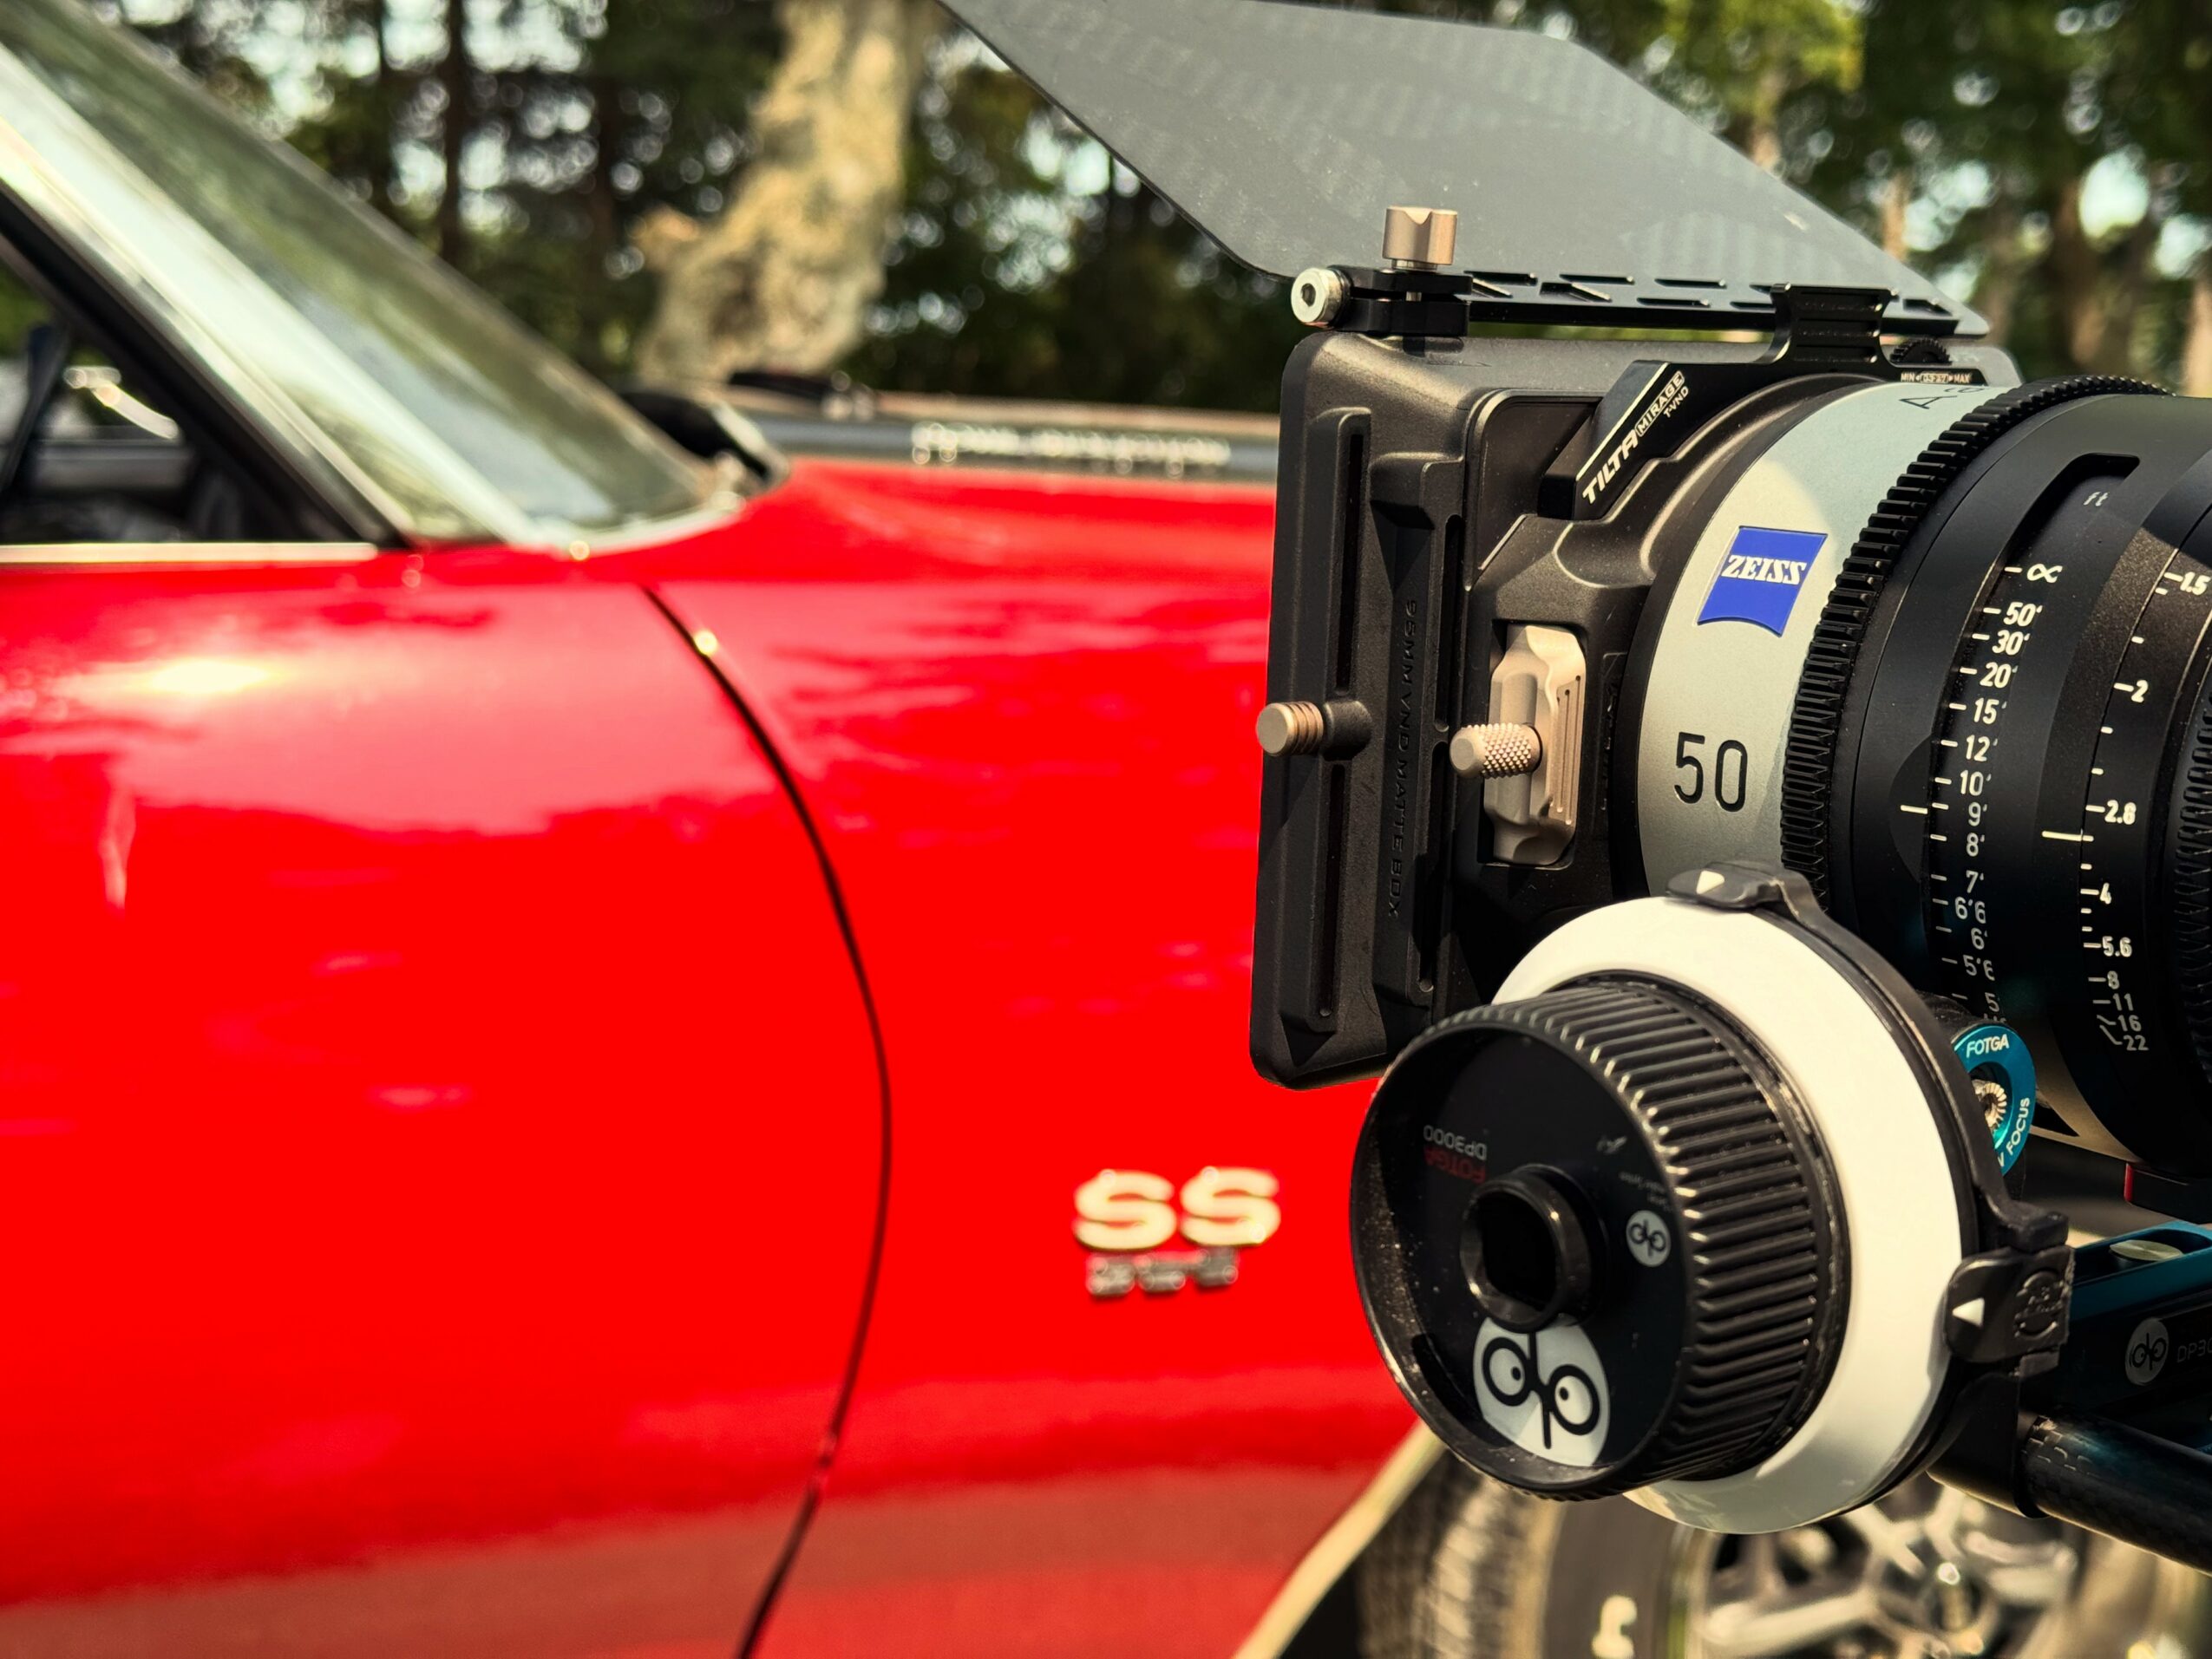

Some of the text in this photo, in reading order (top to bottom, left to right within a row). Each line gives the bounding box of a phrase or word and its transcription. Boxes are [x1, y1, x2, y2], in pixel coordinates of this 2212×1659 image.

[1901, 373, 1914, 382] MIN
[1953, 373, 1971, 383] MAX
[1663, 386, 1689, 418] T-VND
[1582, 372, 1684, 504] TILTA MIRAGE
[2084, 492, 2109, 506] ft
[1721, 555, 1807, 585] ZEISS
[2180, 572, 2211, 596] 1.5
[2131, 680, 2149, 702] 2
[1397, 691, 1414, 752] VND
[1674, 732, 1748, 813] 50
[1391, 759, 1408, 851] MATTE
[2104, 800, 2137, 825] 2.8
[1388, 859, 1403, 918] BOX
[2099, 883, 2112, 905] 4
[2103, 937, 2132, 957] 5.6
[2106, 970, 2120, 990] 8
[2113, 994, 2134, 1011] 11
[2117, 1015, 2142, 1032] 16
[1966, 1034, 2009, 1059] FOTGA
[2124, 1035, 2150, 1051] 22
[2006, 1098, 2030, 1155] FOCUS
[1423, 1124, 1487, 1160] DP3000
[1073, 1166, 1281, 1250] SS
